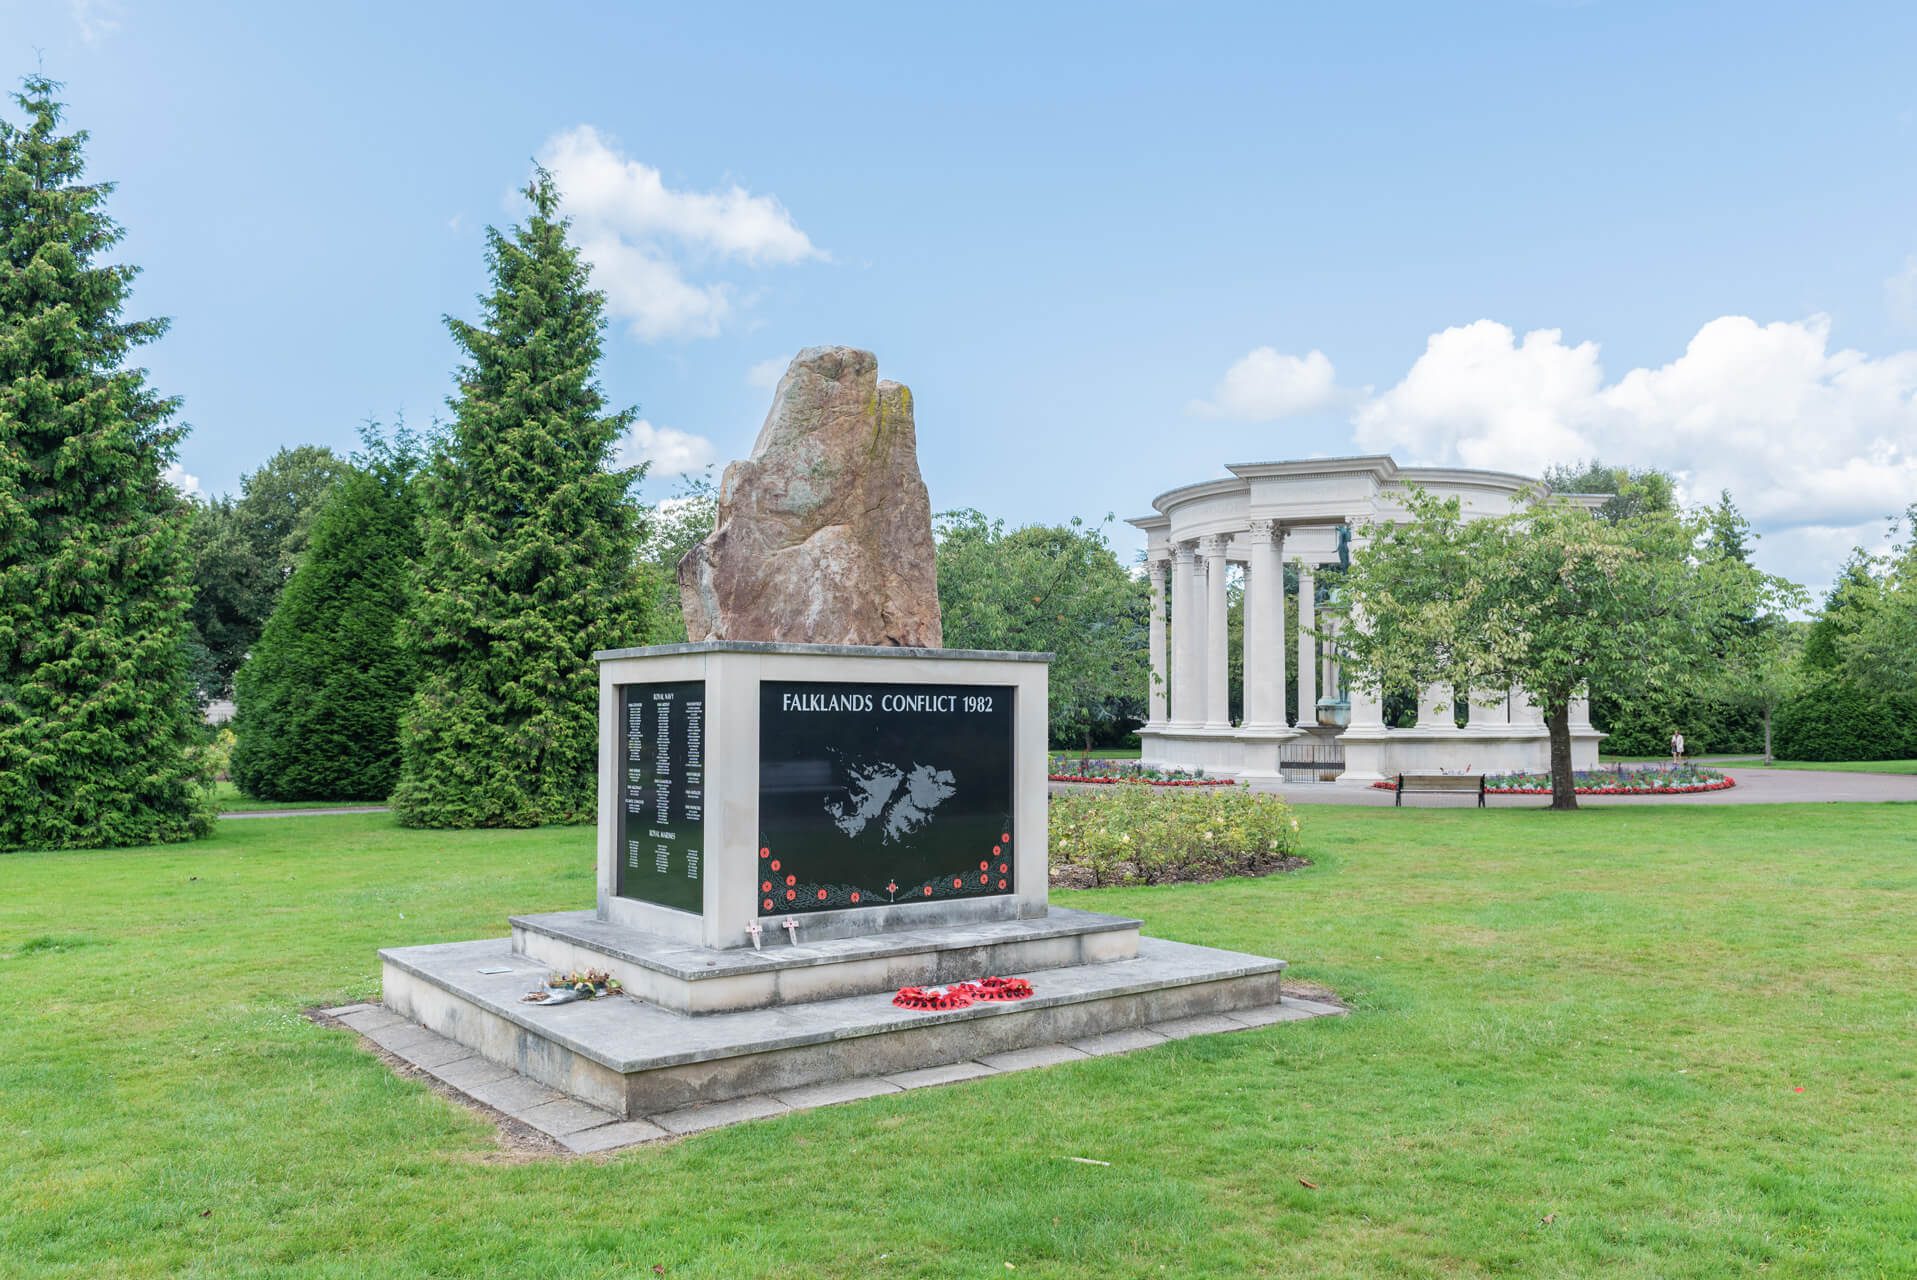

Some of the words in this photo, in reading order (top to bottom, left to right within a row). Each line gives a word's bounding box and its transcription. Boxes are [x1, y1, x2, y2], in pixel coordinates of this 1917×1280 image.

[783, 693, 873, 712] FALKLANDS
[881, 694, 957, 713] CONFLICT
[962, 696, 993, 713] 1982
